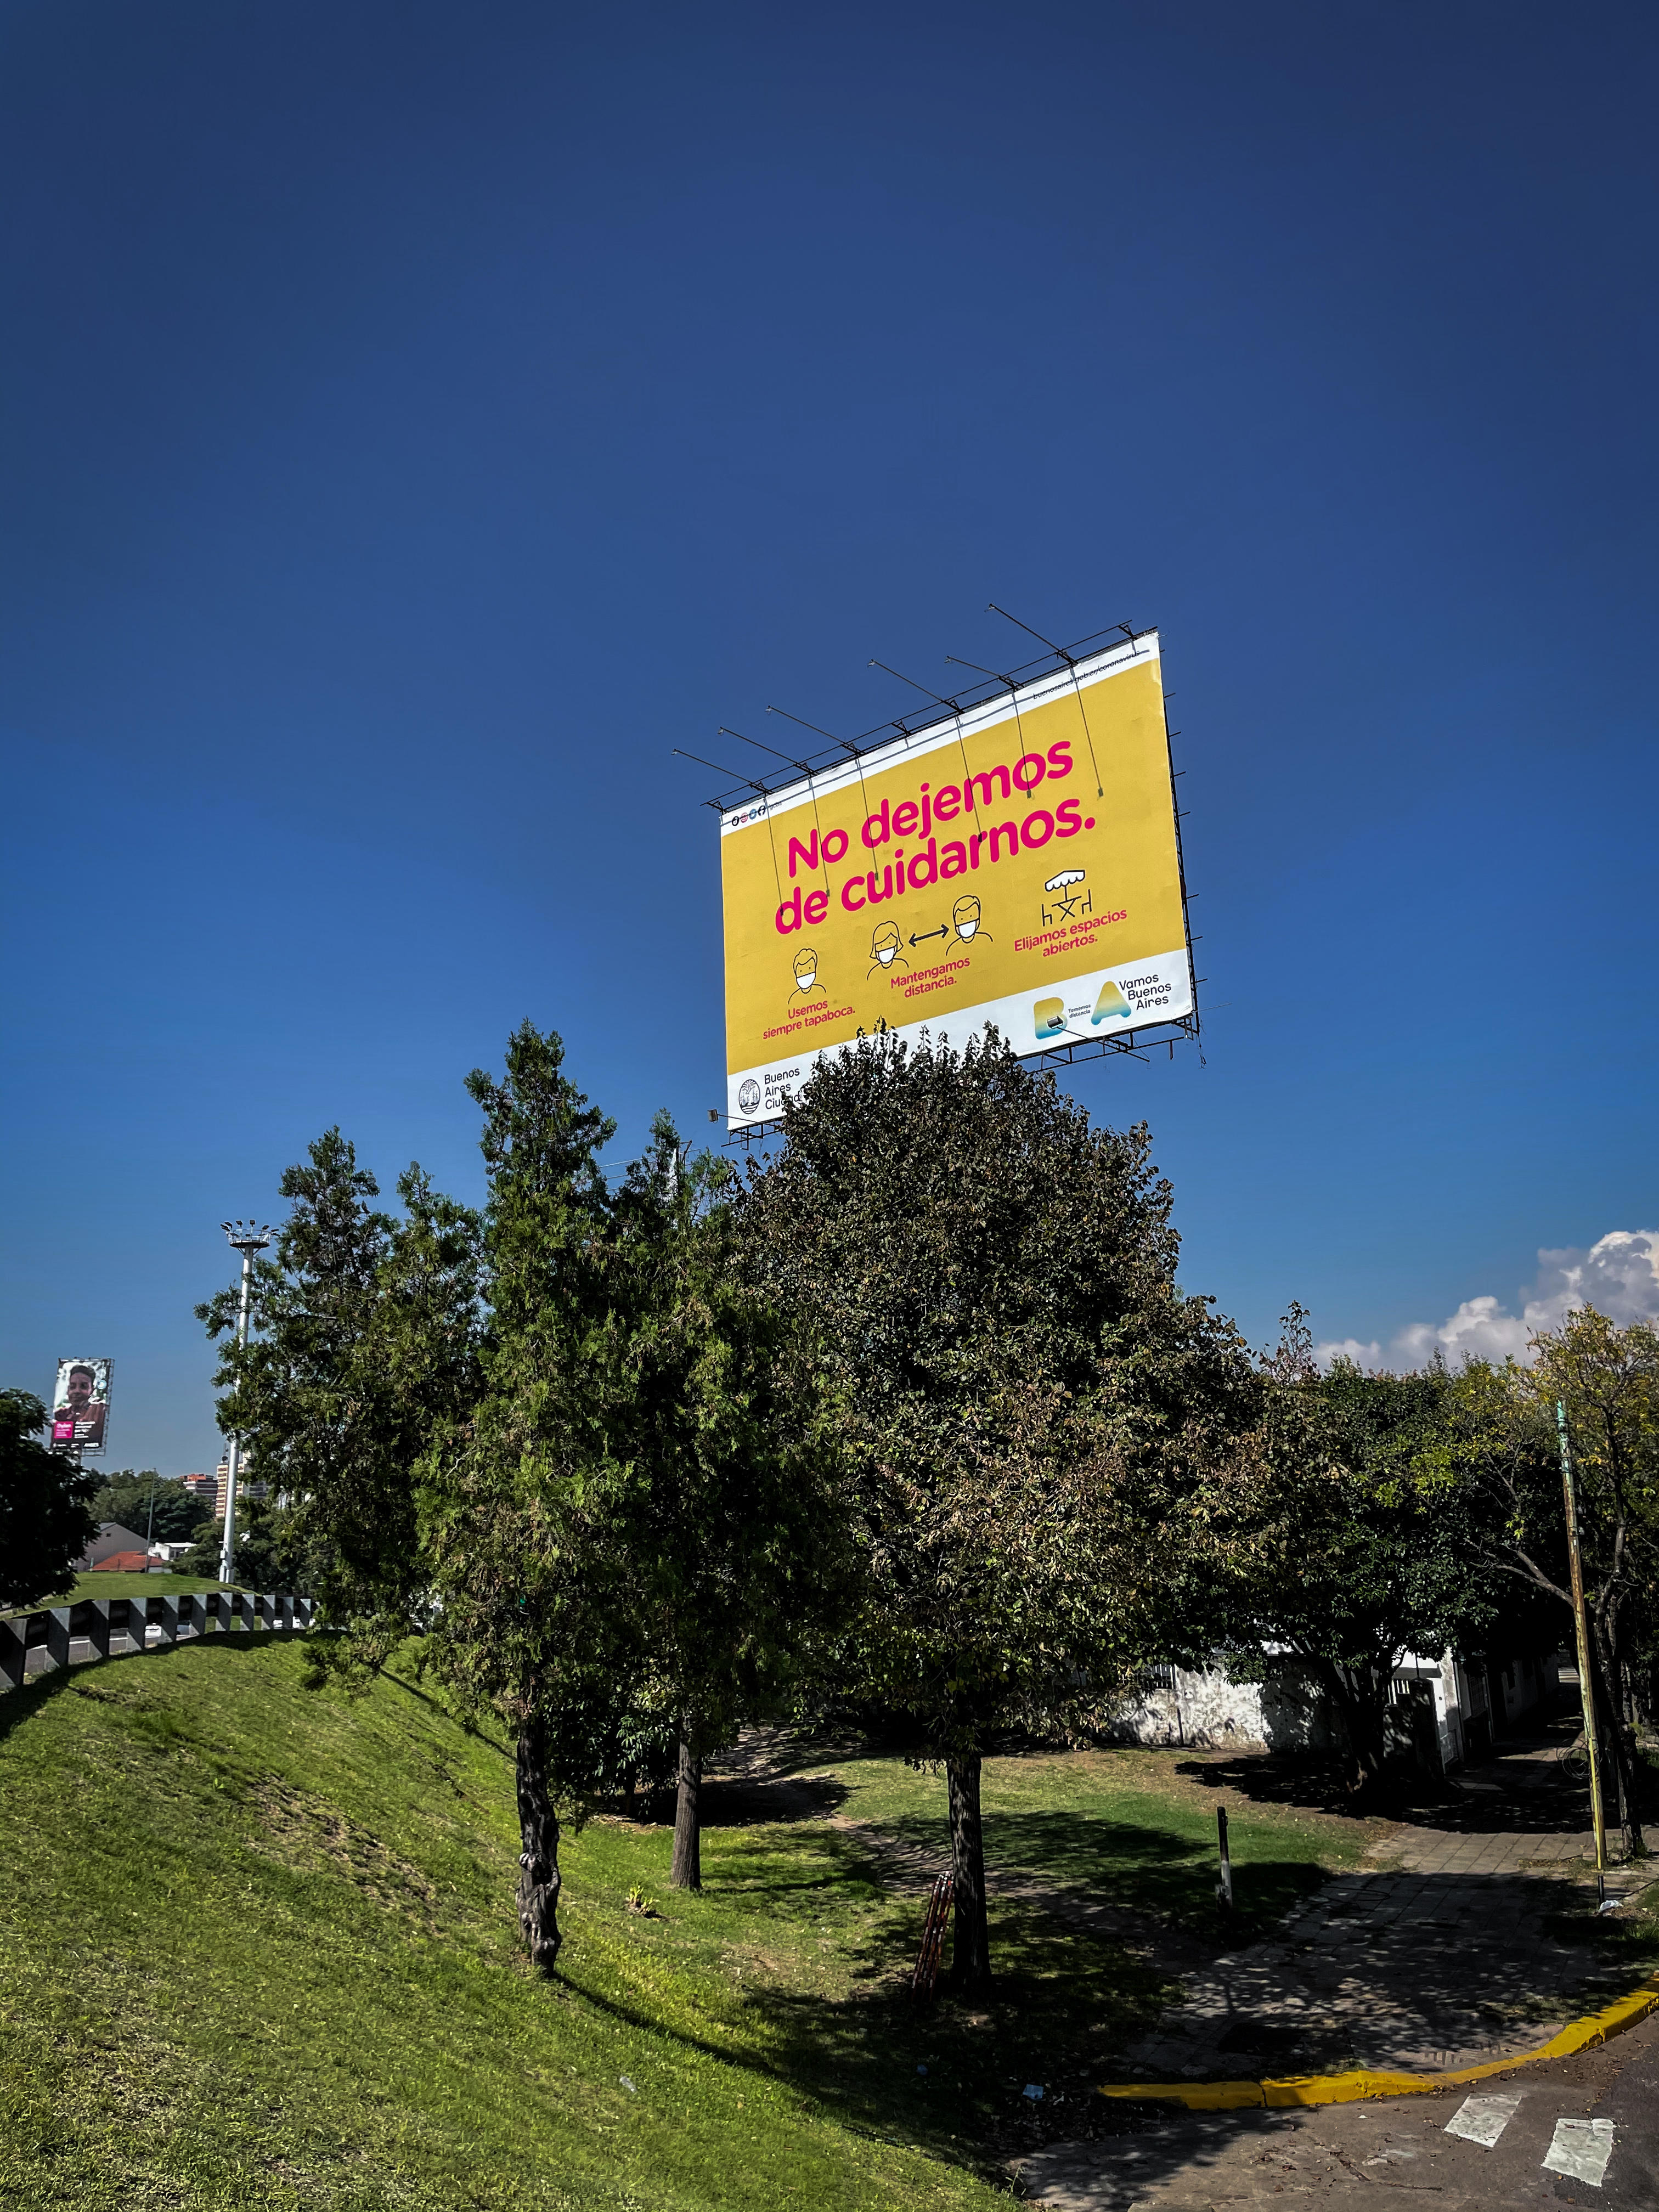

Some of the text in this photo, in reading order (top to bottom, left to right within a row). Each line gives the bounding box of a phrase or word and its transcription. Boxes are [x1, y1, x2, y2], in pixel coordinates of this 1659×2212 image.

[1033, 651, 1140, 699] buenosaires.gob.ar/coronavirus
[788, 741, 1073, 878] No dejemos
[775, 798, 1096, 934] de cuidarnos.
[1014, 909, 1127, 952] Elijamos espacios
[1042, 934, 1098, 957] abiertos.
[890, 957, 970, 989] Mantengamos
[1119, 974, 1159, 991] Vamos
[904, 975, 957, 998] distancia.
[1128, 983, 1172, 1001] Buenos
[788, 1000, 828, 1019] Usemos
[1069, 1009, 1091, 1018] distancia
[1136, 995, 1169, 1011] Aires
[763, 1006, 856, 1040] siempre tapaboca.
[764, 1068, 800, 1085] Buenos
[765, 1083, 791, 1098] Aires
